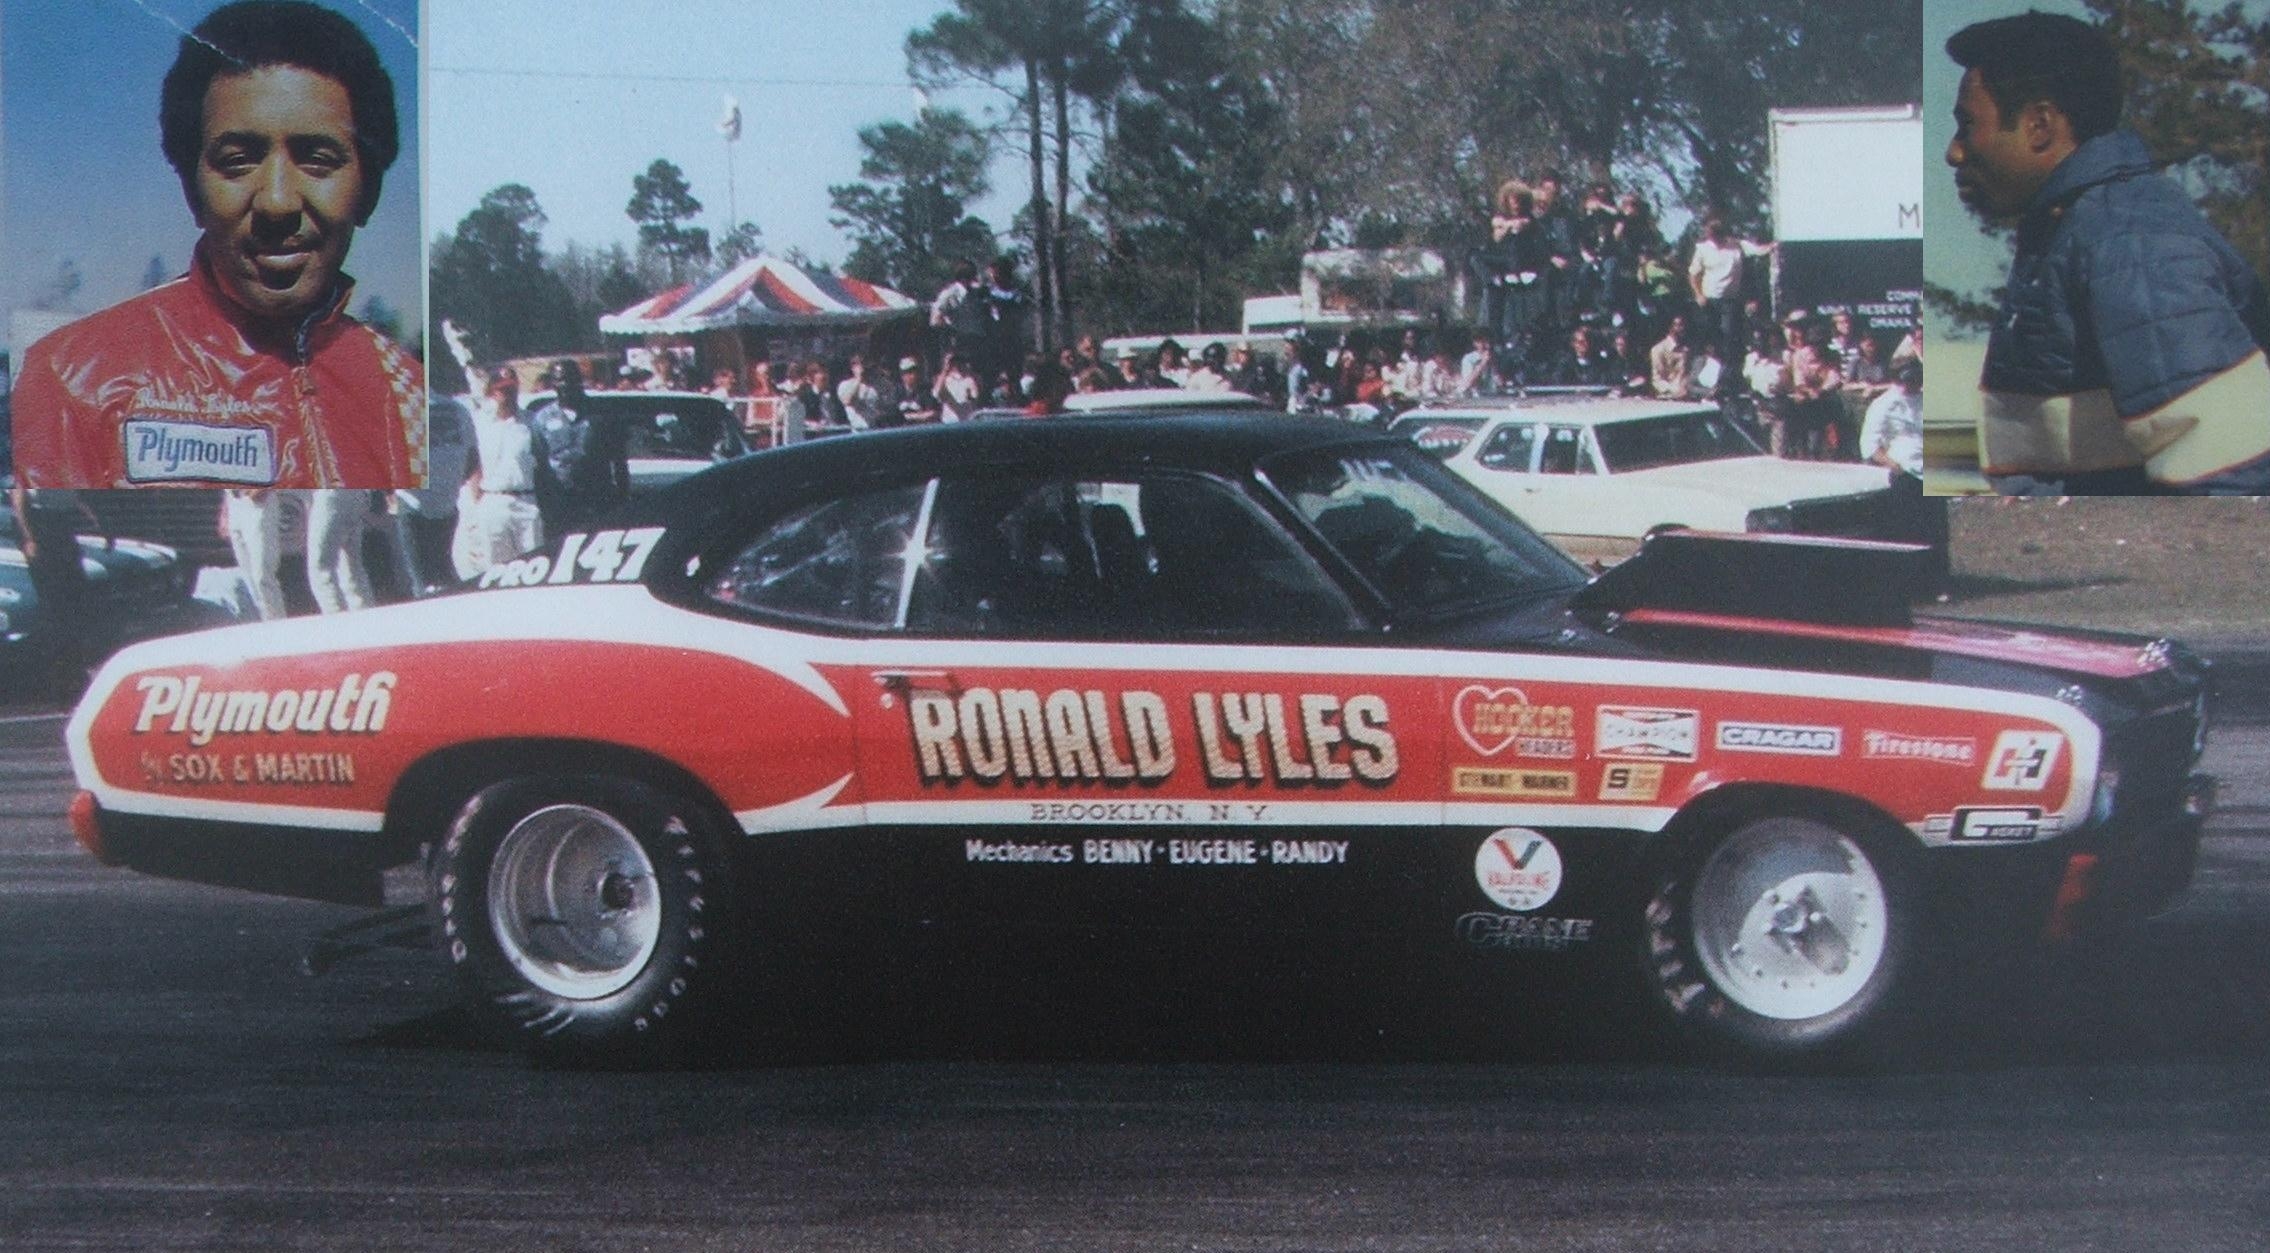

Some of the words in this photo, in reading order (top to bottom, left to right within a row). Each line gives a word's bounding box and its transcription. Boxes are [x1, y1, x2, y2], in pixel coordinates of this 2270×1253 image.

[135, 427, 257, 473] Plymouth
[478, 556, 550, 588] PRO
[548, 527, 667, 583] 147
[135, 671, 397, 747] Plymouth
[1472, 703, 1574, 738] HOOKER
[909, 688, 1176, 785] RONALD
[1193, 691, 1399, 788] LYLES
[1722, 728, 1833, 749] CRAGAR
[1867, 735, 1973, 760] Firestone
[169, 754, 224, 781] SOX
[233, 755, 250, 781] &
[255, 753, 355, 783] MARTIN
[965, 838, 1074, 862] Mechanics
